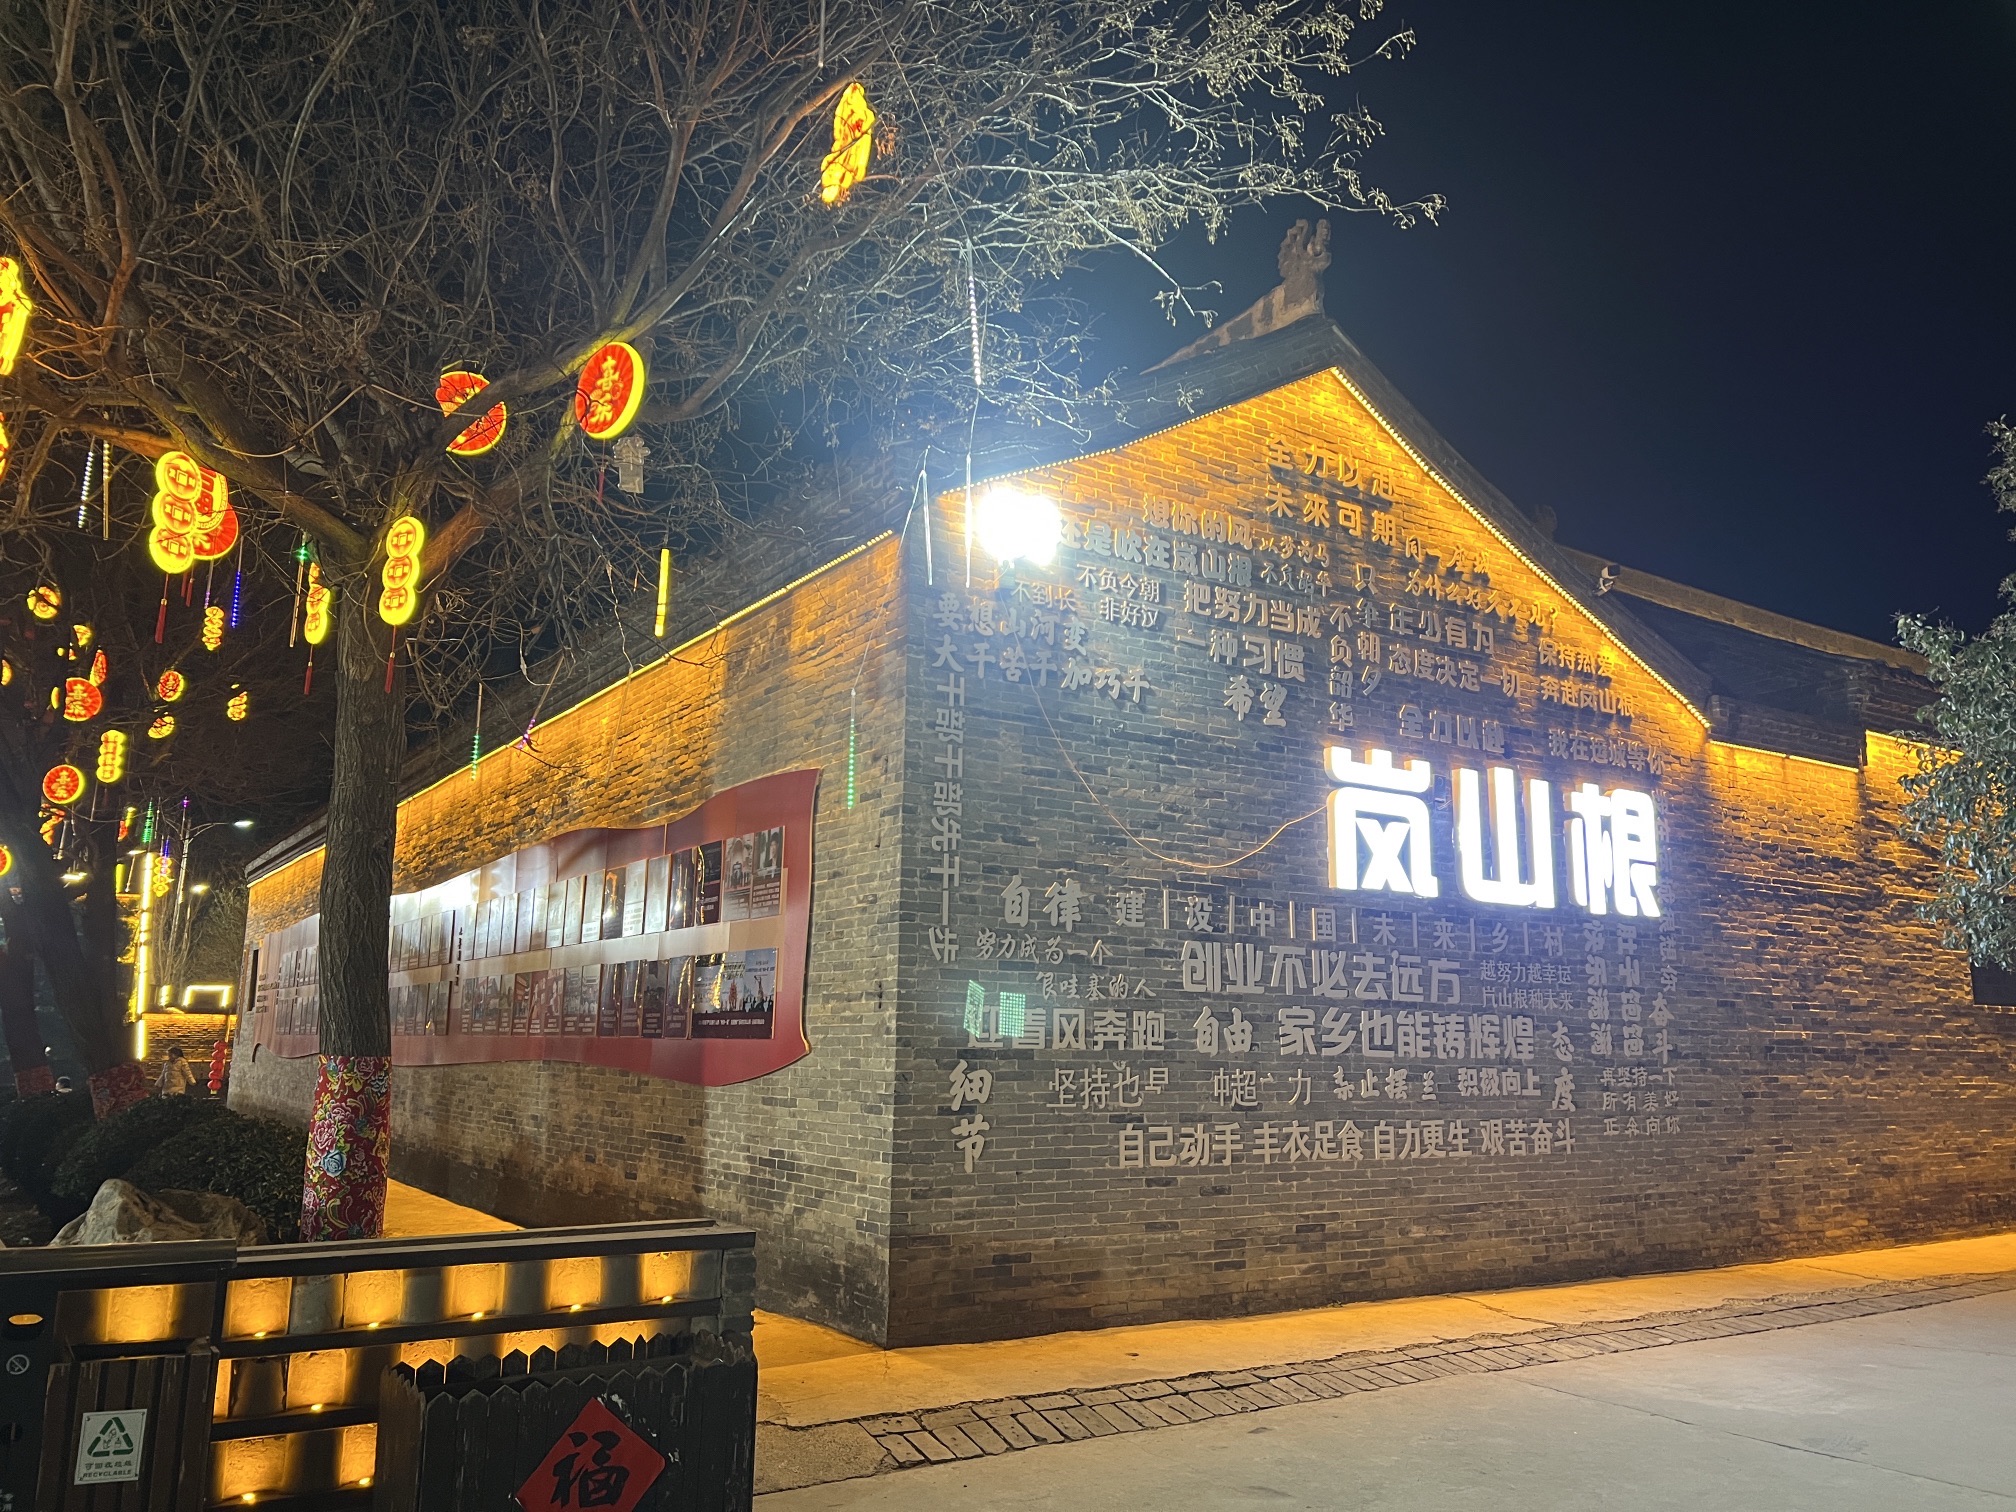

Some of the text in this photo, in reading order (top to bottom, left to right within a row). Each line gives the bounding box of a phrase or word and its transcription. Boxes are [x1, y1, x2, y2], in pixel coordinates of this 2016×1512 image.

[1266, 432, 1396, 500] 全力以赴
[1143, 492, 1253, 551] 想你的风
[1259, 535, 1330, 568] 以梦为马
[1405, 534, 1490, 573] 同一座城
[1076, 563, 1161, 602] 不负今朝
[1260, 563, 1333, 597] 不负韶华
[932, 591, 1088, 656] 要想山河变
[1100, 597, 1159, 628] 非好汉
[1184, 579, 1322, 639] 把努力当成
[1354, 563, 1382, 696] 只争朝夕
[931, 634, 1150, 704] 大干苦干加巧干
[1177, 629, 1306, 683] 一种习惯
[1329, 603, 1354, 732] 不负韶华
[1388, 643, 1521, 698] 态度决定一切
[1538, 637, 1615, 677] 保持热爱
[1223, 674, 1288, 728] 希望
[1540, 675, 1635, 719] 奔赴岚山根
[1398, 704, 1505, 754] 全力以赴
[1548, 728, 1666, 775] 我在运城等你
[928, 672, 966, 964] 干部干部先干一步
[1323, 745, 1662, 919] 岚山根
[1000, 874, 1083, 933] 自律
[975, 927, 1114, 966] 努力成为一个
[1180, 941, 1461, 1005] 创业不必去远方
[1479, 959, 1573, 985] 越努力越幸运
[1583, 919, 1613, 1056] 快乐满满
[1616, 922, 1645, 1057] 肚子饱饱
[967, 1005, 1165, 1051] 迎着风奔跑
[1192, 1006, 1254, 1058] 自由
[1278, 1005, 1536, 1060] 家乡也能铸辉煌
[1648, 991, 1675, 1065] 奋斗
[1458, 1067, 1542, 1098] 积极向上
[1551, 1020, 1576, 1112] 态度
[1600, 1066, 1678, 1088] 再坚持一下
[948, 1059, 993, 1174] 细节
[1118, 1117, 1577, 1169] 自己动手 丰衣足食 自力更生 艰苦奋斗
[82, 1469, 132, 1478] RECYCLABLE
[550, 1430, 630, 1509] 福
